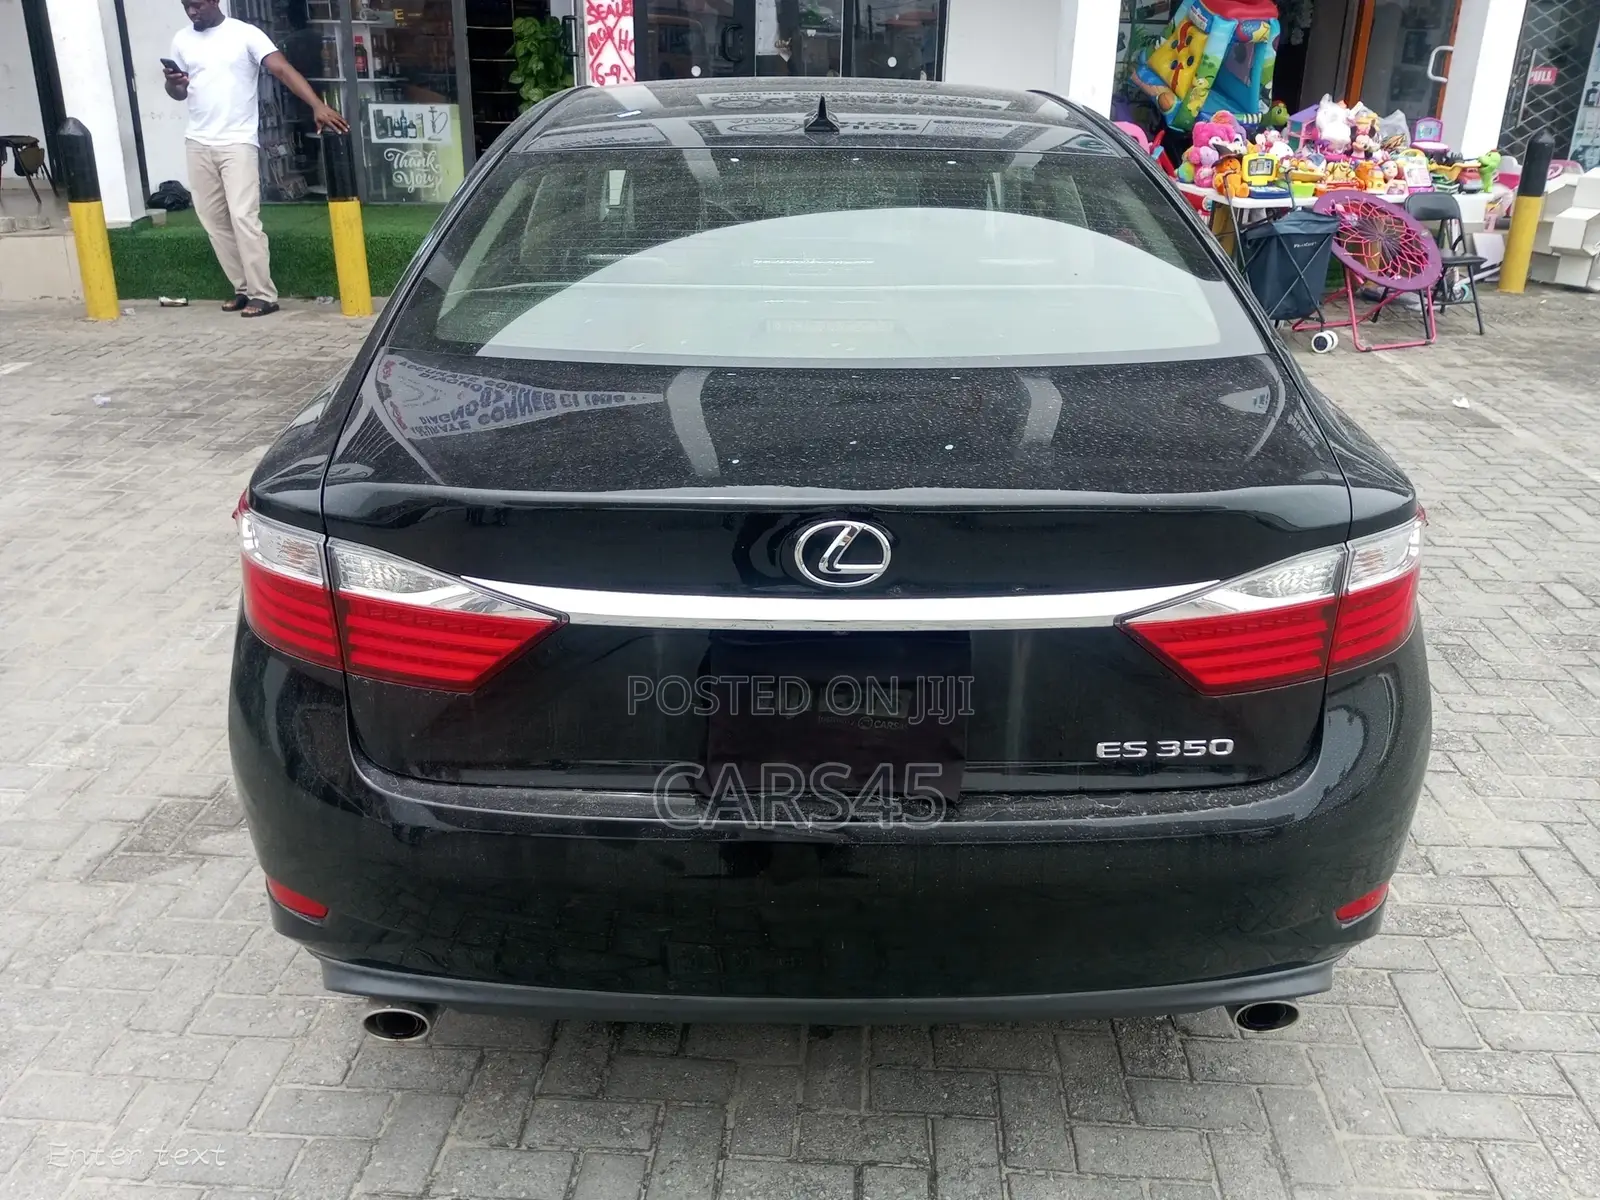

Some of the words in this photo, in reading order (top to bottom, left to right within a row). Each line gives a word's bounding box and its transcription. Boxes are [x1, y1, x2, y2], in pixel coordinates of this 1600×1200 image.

[384, 148, 443, 173] Thank
[1096, 740, 1148, 759] ES
[1156, 738, 1235, 757] 350
